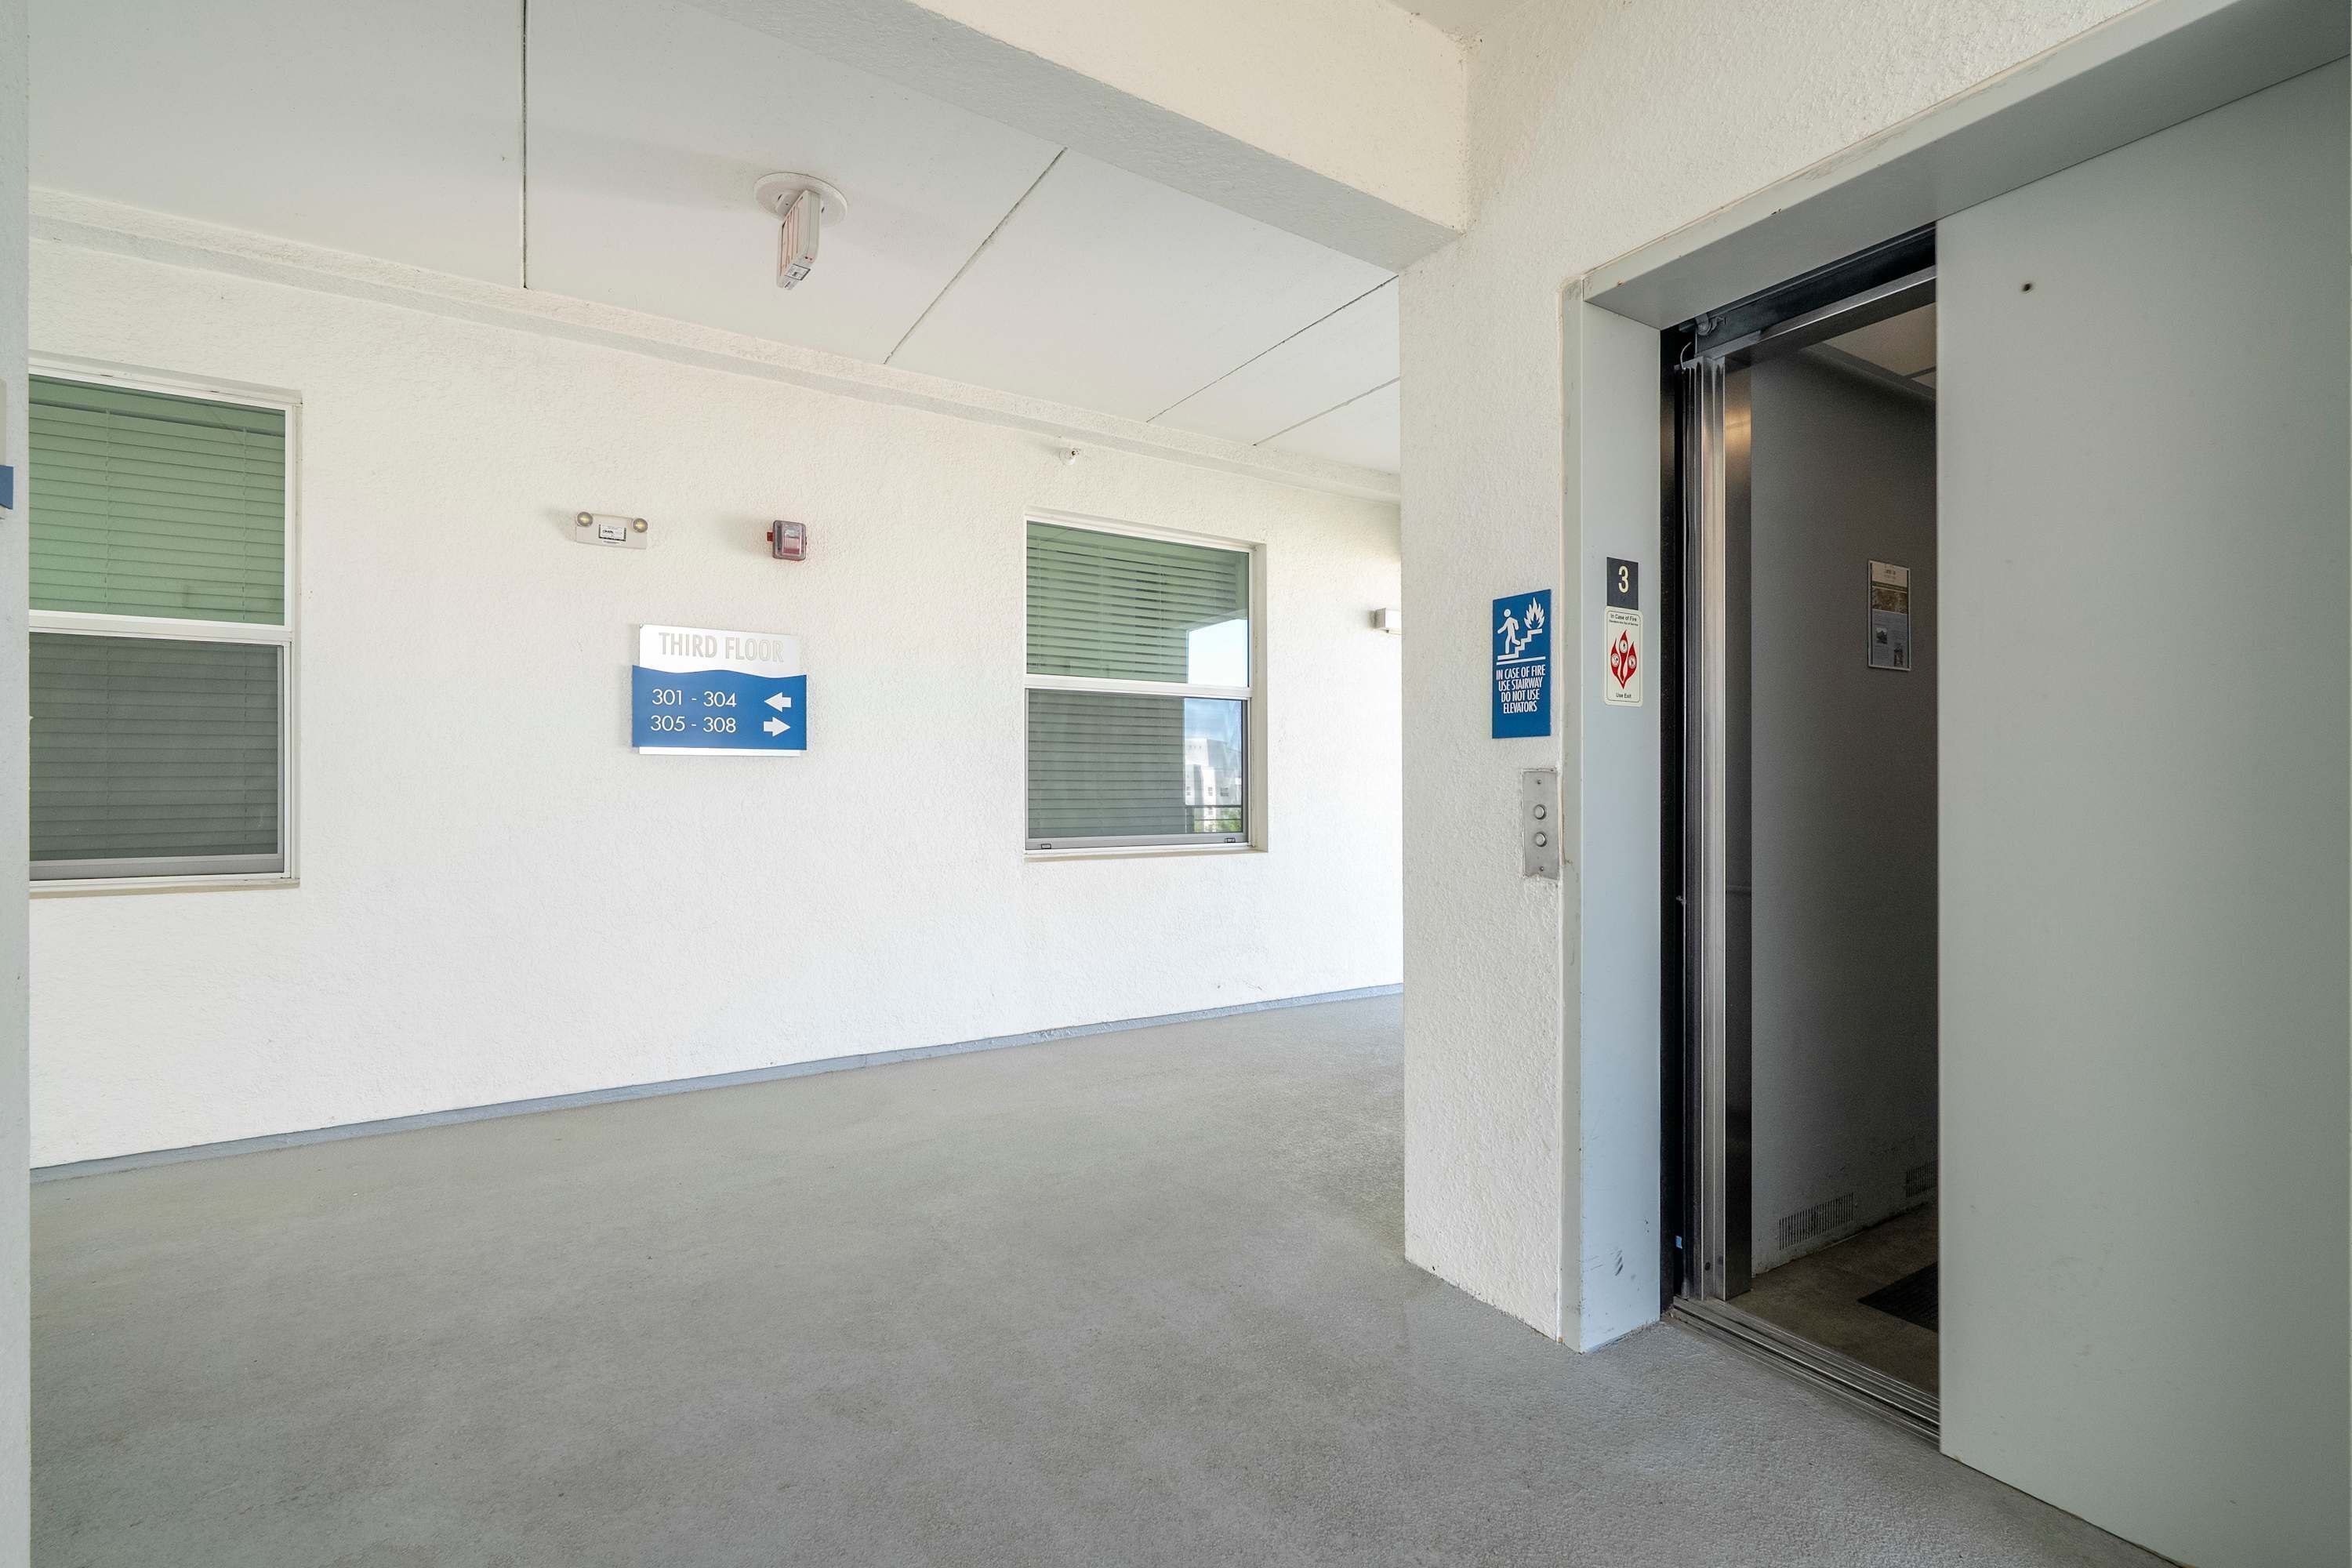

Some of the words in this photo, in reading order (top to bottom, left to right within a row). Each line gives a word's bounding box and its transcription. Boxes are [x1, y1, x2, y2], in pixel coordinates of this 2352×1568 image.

[1618, 565, 1629, 593] 3
[659, 632, 717, 659] THIRD
[725, 637, 784, 662] FLOOR
[1496, 670, 1503, 680] IN
[1504, 668, 1519, 679] CASE
[1521, 666, 1530, 677] OF
[1531, 665, 1545, 676] FIRE
[1498, 680, 1510, 691] USE
[1512, 677, 1543, 690] STAIRWAY
[652, 688, 682, 706] 301
[703, 691, 737, 707] 304
[1501, 691, 1511, 702] DO
[1512, 690, 1526, 701] NOT
[1527, 689, 1540, 700] USE
[1503, 701, 1537, 713] ELEVATORS
[650, 715, 685, 731] 305
[702, 717, 737, 733] 308
